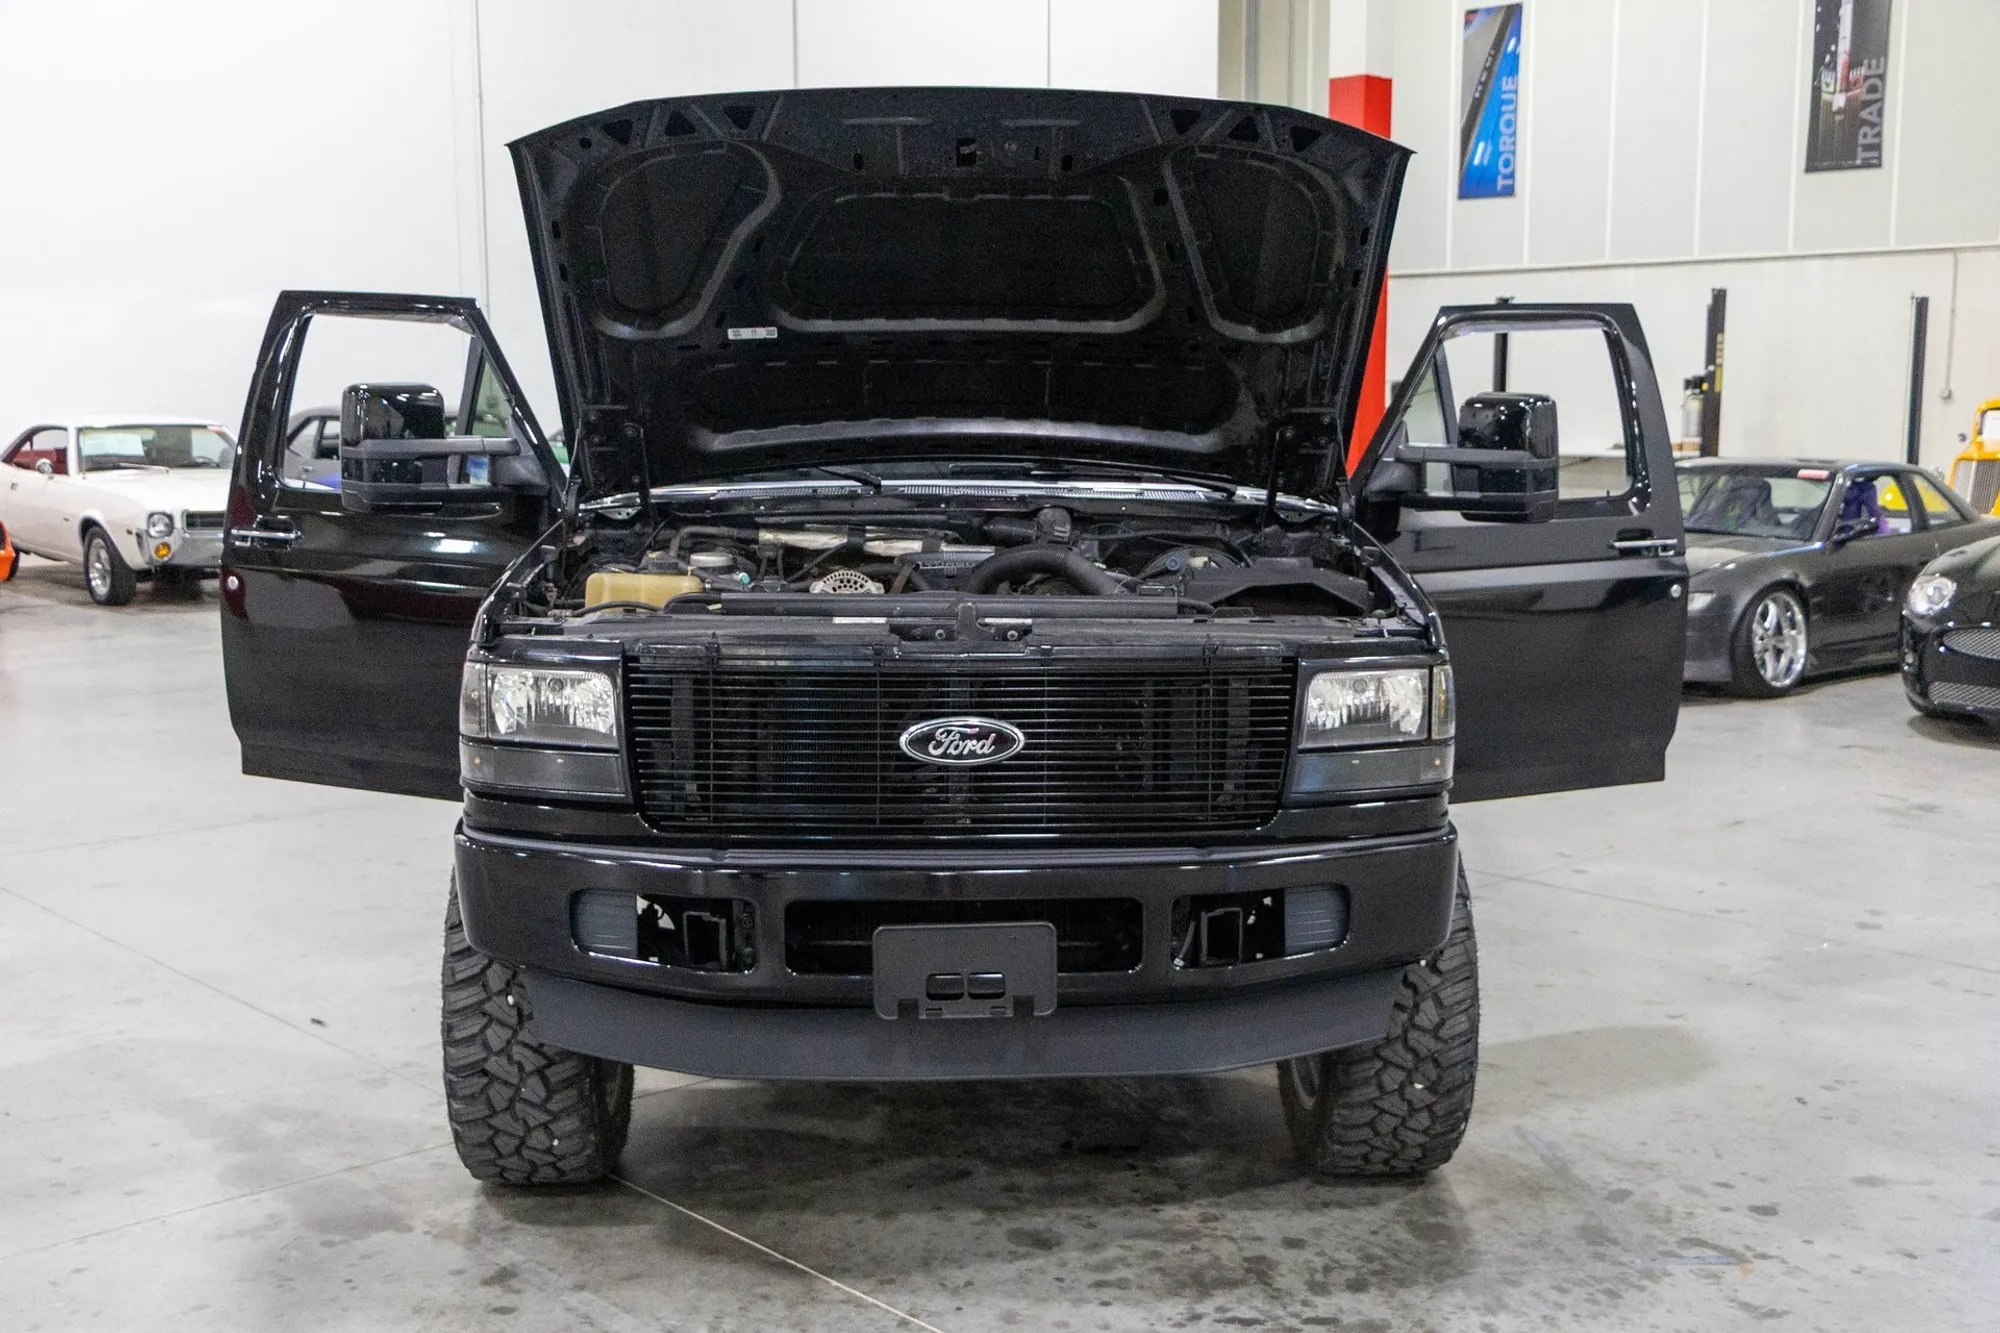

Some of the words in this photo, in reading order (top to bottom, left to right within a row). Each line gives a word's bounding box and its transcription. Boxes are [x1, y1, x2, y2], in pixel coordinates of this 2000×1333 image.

[1497, 75, 1518, 191] TORQUE
[1856, 57, 1885, 165] TRADE
[928, 727, 996, 756] Ford
